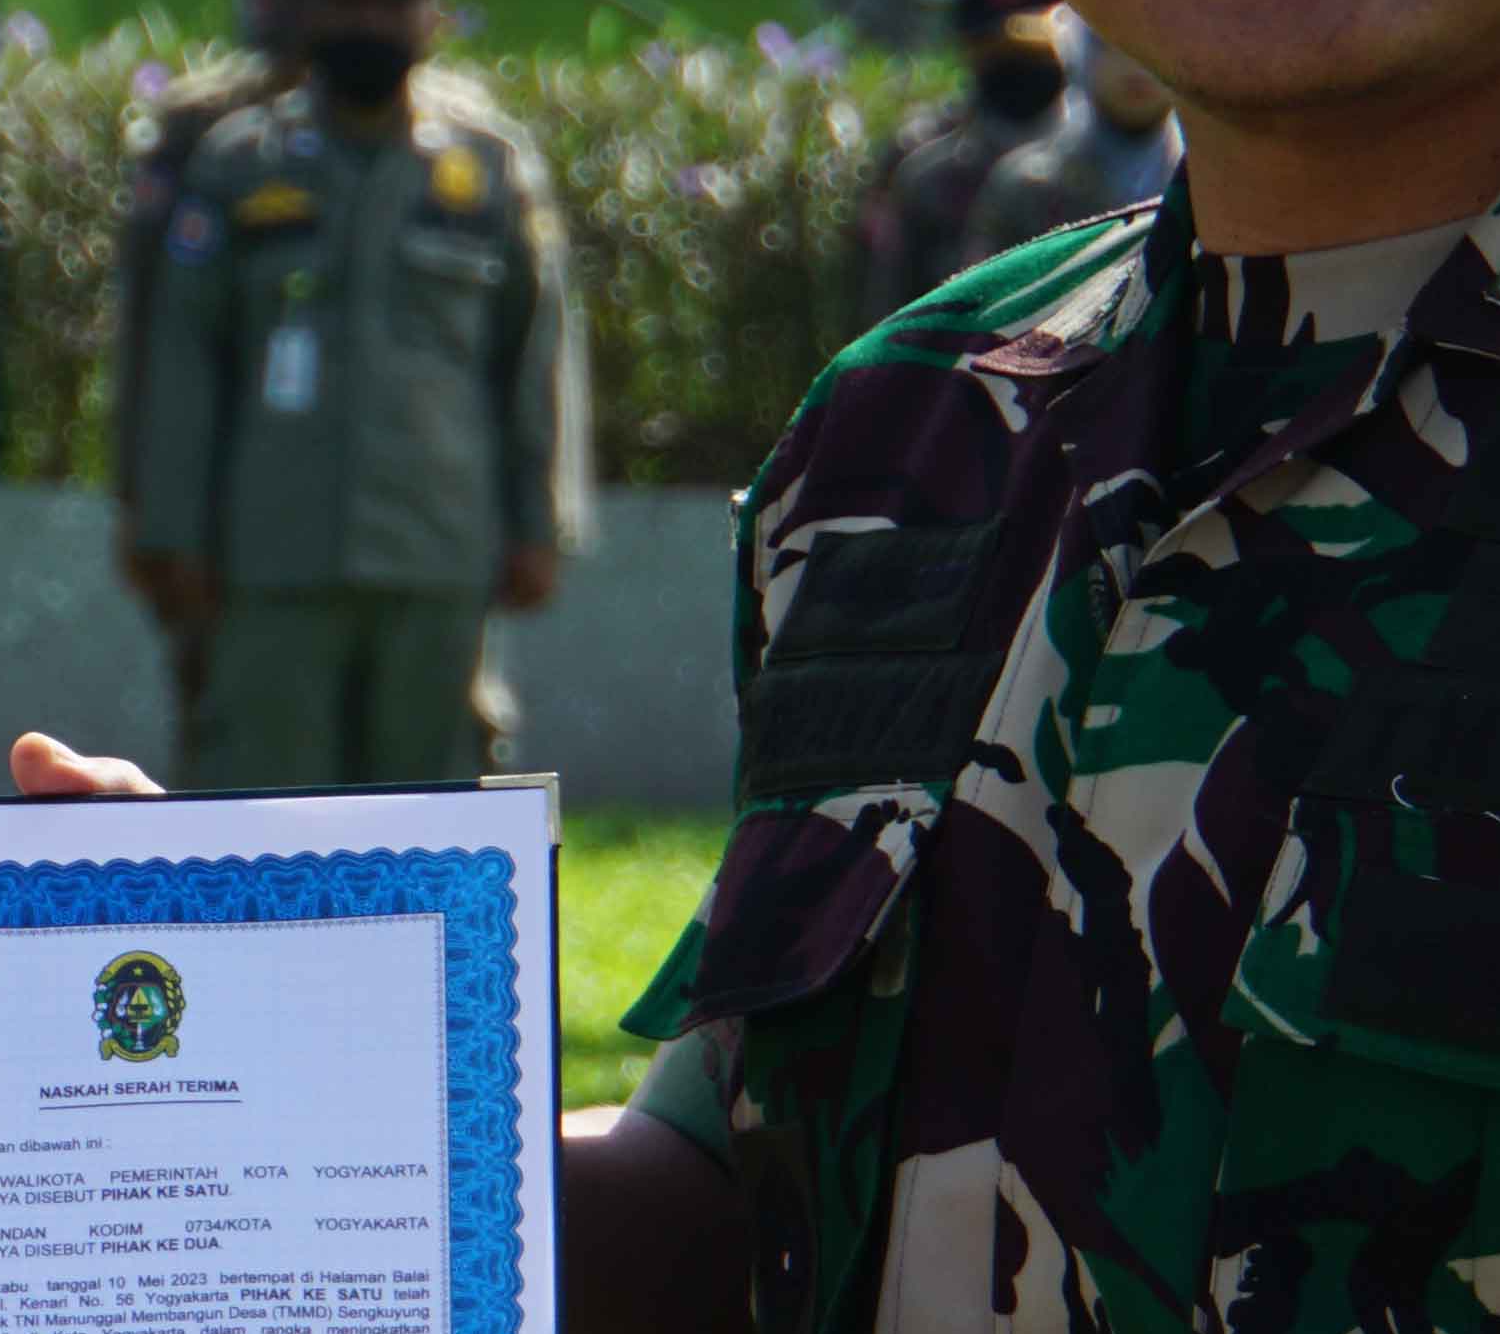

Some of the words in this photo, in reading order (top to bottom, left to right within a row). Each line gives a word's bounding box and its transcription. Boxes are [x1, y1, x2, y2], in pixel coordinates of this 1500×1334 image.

[39, 1083, 109, 1099] NASKAH
[112, 1080, 172, 1095] SERAH
[174, 1079, 240, 1093] TERIMA
[18, 1138, 81, 1152] dibawah
[85, 1137, 104, 1149] ini
[0, 1172, 86, 1187] WALIKOTA
[109, 1166, 218, 1183] PEMERINTAH
[243, 1165, 289, 1179] KOTA
[312, 1163, 428, 1178] YOGYAKARTA
[24, 1188, 98, 1204] DISEBUT
[100, 1186, 152, 1201] PIHAK
[156, 1184, 180, 1199] KE
[88, 1222, 144, 1238] KODIM
[184, 1217, 272, 1232] 0734/KOTA
[314, 1216, 430, 1230] YOGYAKARTA
[24, 1241, 97, 1257] DISEBUT
[99, 1239, 152, 1254] PIHAK
[155, 1237, 180, 1251] KE
[45, 1277, 104, 1294] tanggal
[108, 1275, 126, 1289] 10
[137, 1274, 166, 1288] Mei
[170, 1272, 208, 1286] 2023
[219, 1271, 295, 1285] bertempat
[299, 1270, 314, 1283] di
[319, 1270, 387, 1283] Halaman
[391, 1268, 430, 1283] Balai
[19, 1295, 68, 1310] Kenari
[115, 1292, 135, 1306] 56
[144, 1290, 230, 1307] Yogyakarta
[239, 1287, 293, 1301] PIHAK
[302, 1287, 328, 1301] KE
[336, 1287, 383, 1301] SATU
[393, 1287, 431, 1300] telah
[12, 1314, 40, 1327] TNI
[44, 1311, 127, 1328] Manunggal
[130, 1305, 224, 1325] Membangun
[228, 1305, 268, 1319] Desa
[271, 1304, 334, 1321] (TMMD)
[336, 1305, 431, 1322] Sengkuyung
